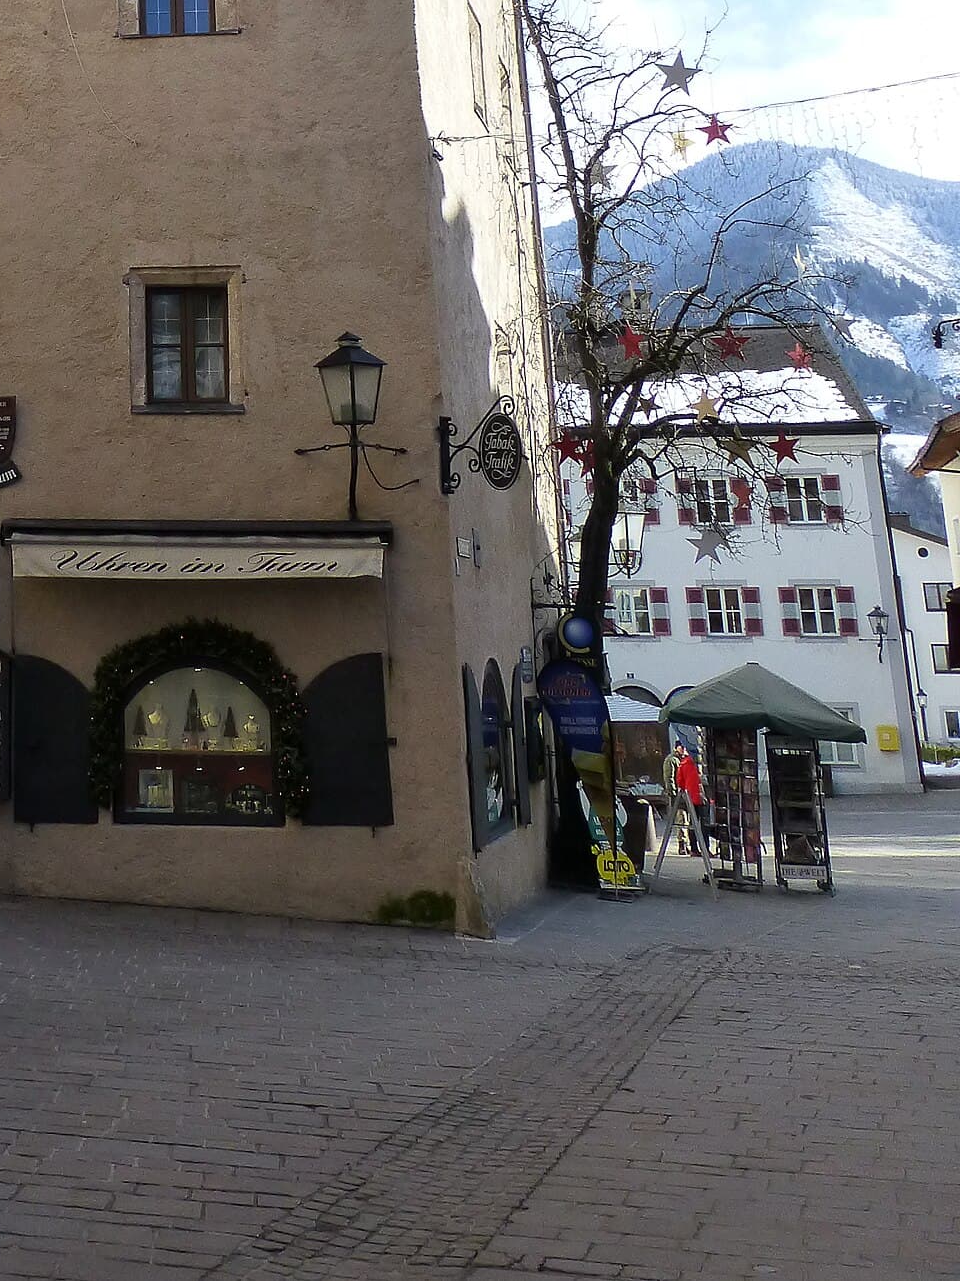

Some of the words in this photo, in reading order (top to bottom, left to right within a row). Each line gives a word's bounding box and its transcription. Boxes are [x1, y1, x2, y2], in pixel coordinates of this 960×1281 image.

[484, 432, 517, 451] Tabak
[485, 451, 517, 471] Trafik
[50, 549, 169, 574] Uhren
[180, 556, 226, 573] im
[237, 551, 339, 574] Turm
